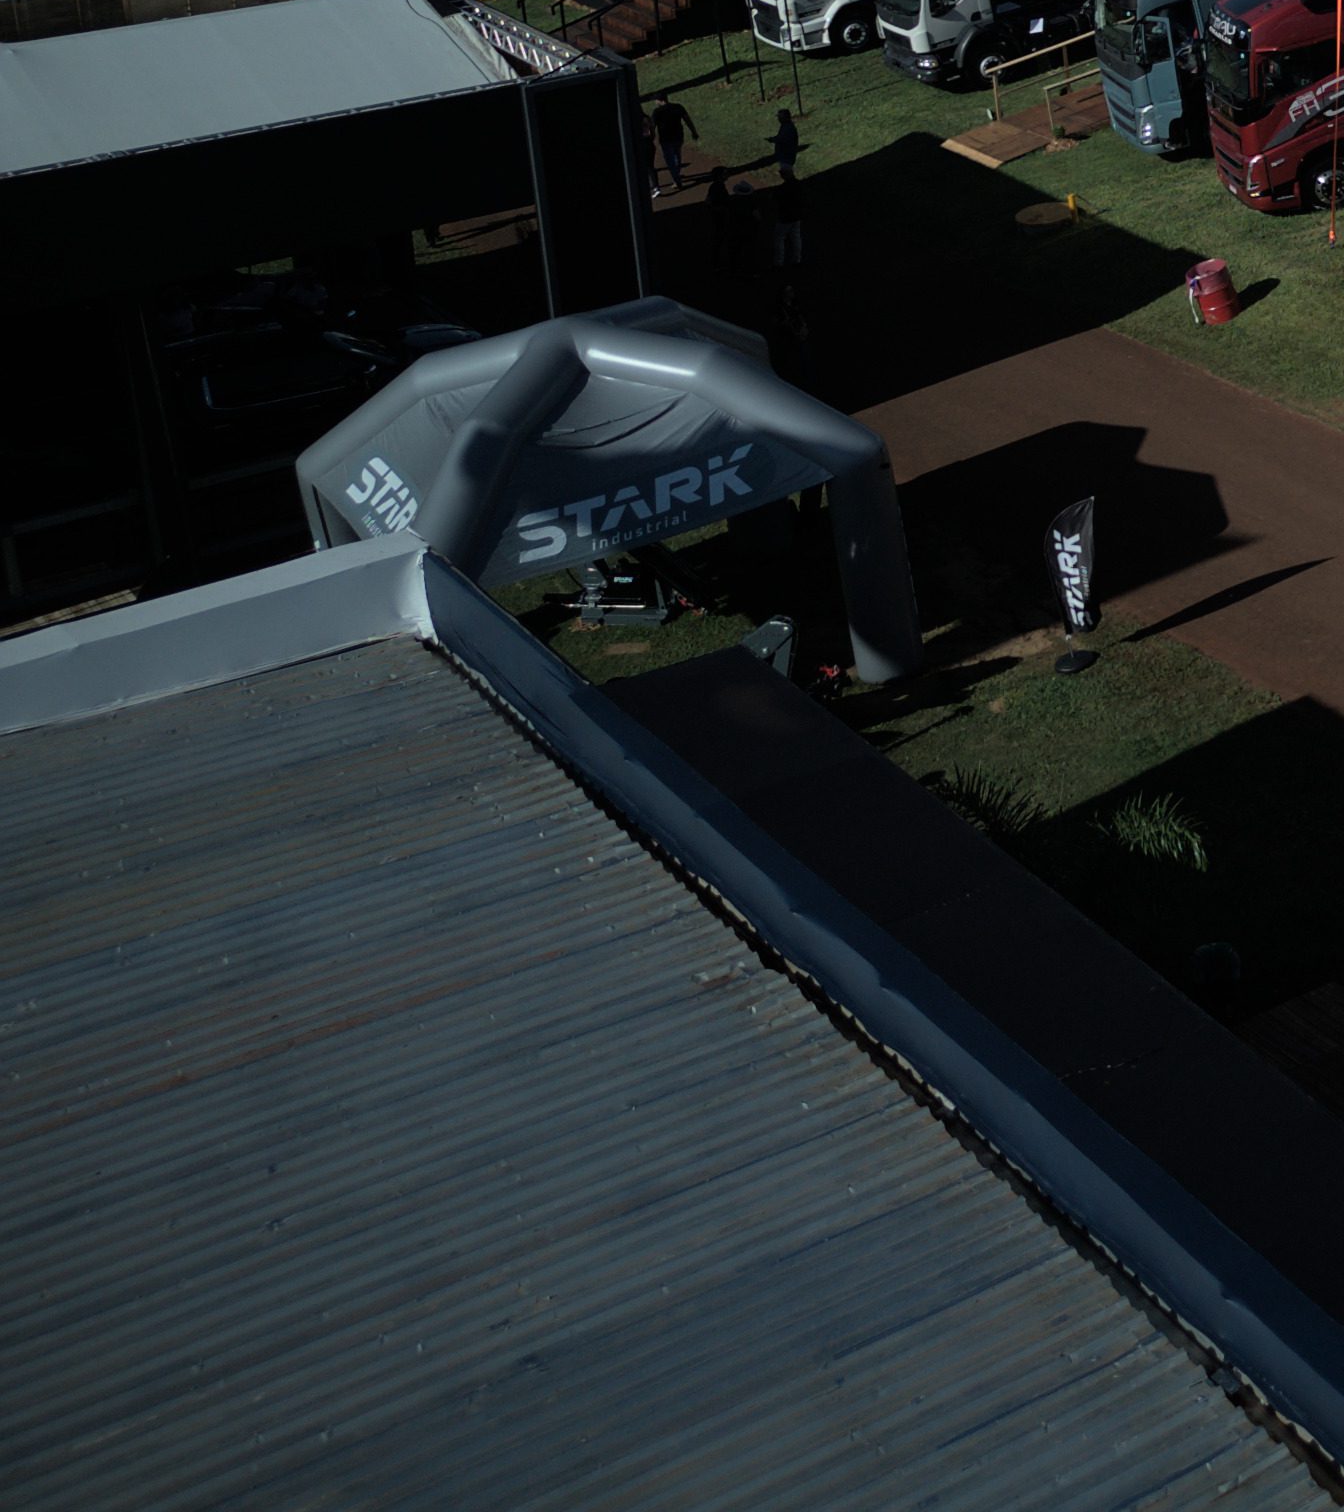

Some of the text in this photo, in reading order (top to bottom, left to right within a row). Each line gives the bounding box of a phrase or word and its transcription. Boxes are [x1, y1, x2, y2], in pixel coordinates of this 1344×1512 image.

[346, 456, 419, 535] STAR
[519, 443, 754, 564] STARK
[591, 512, 688, 552] industrial
[1053, 529, 1085, 627] STARK
